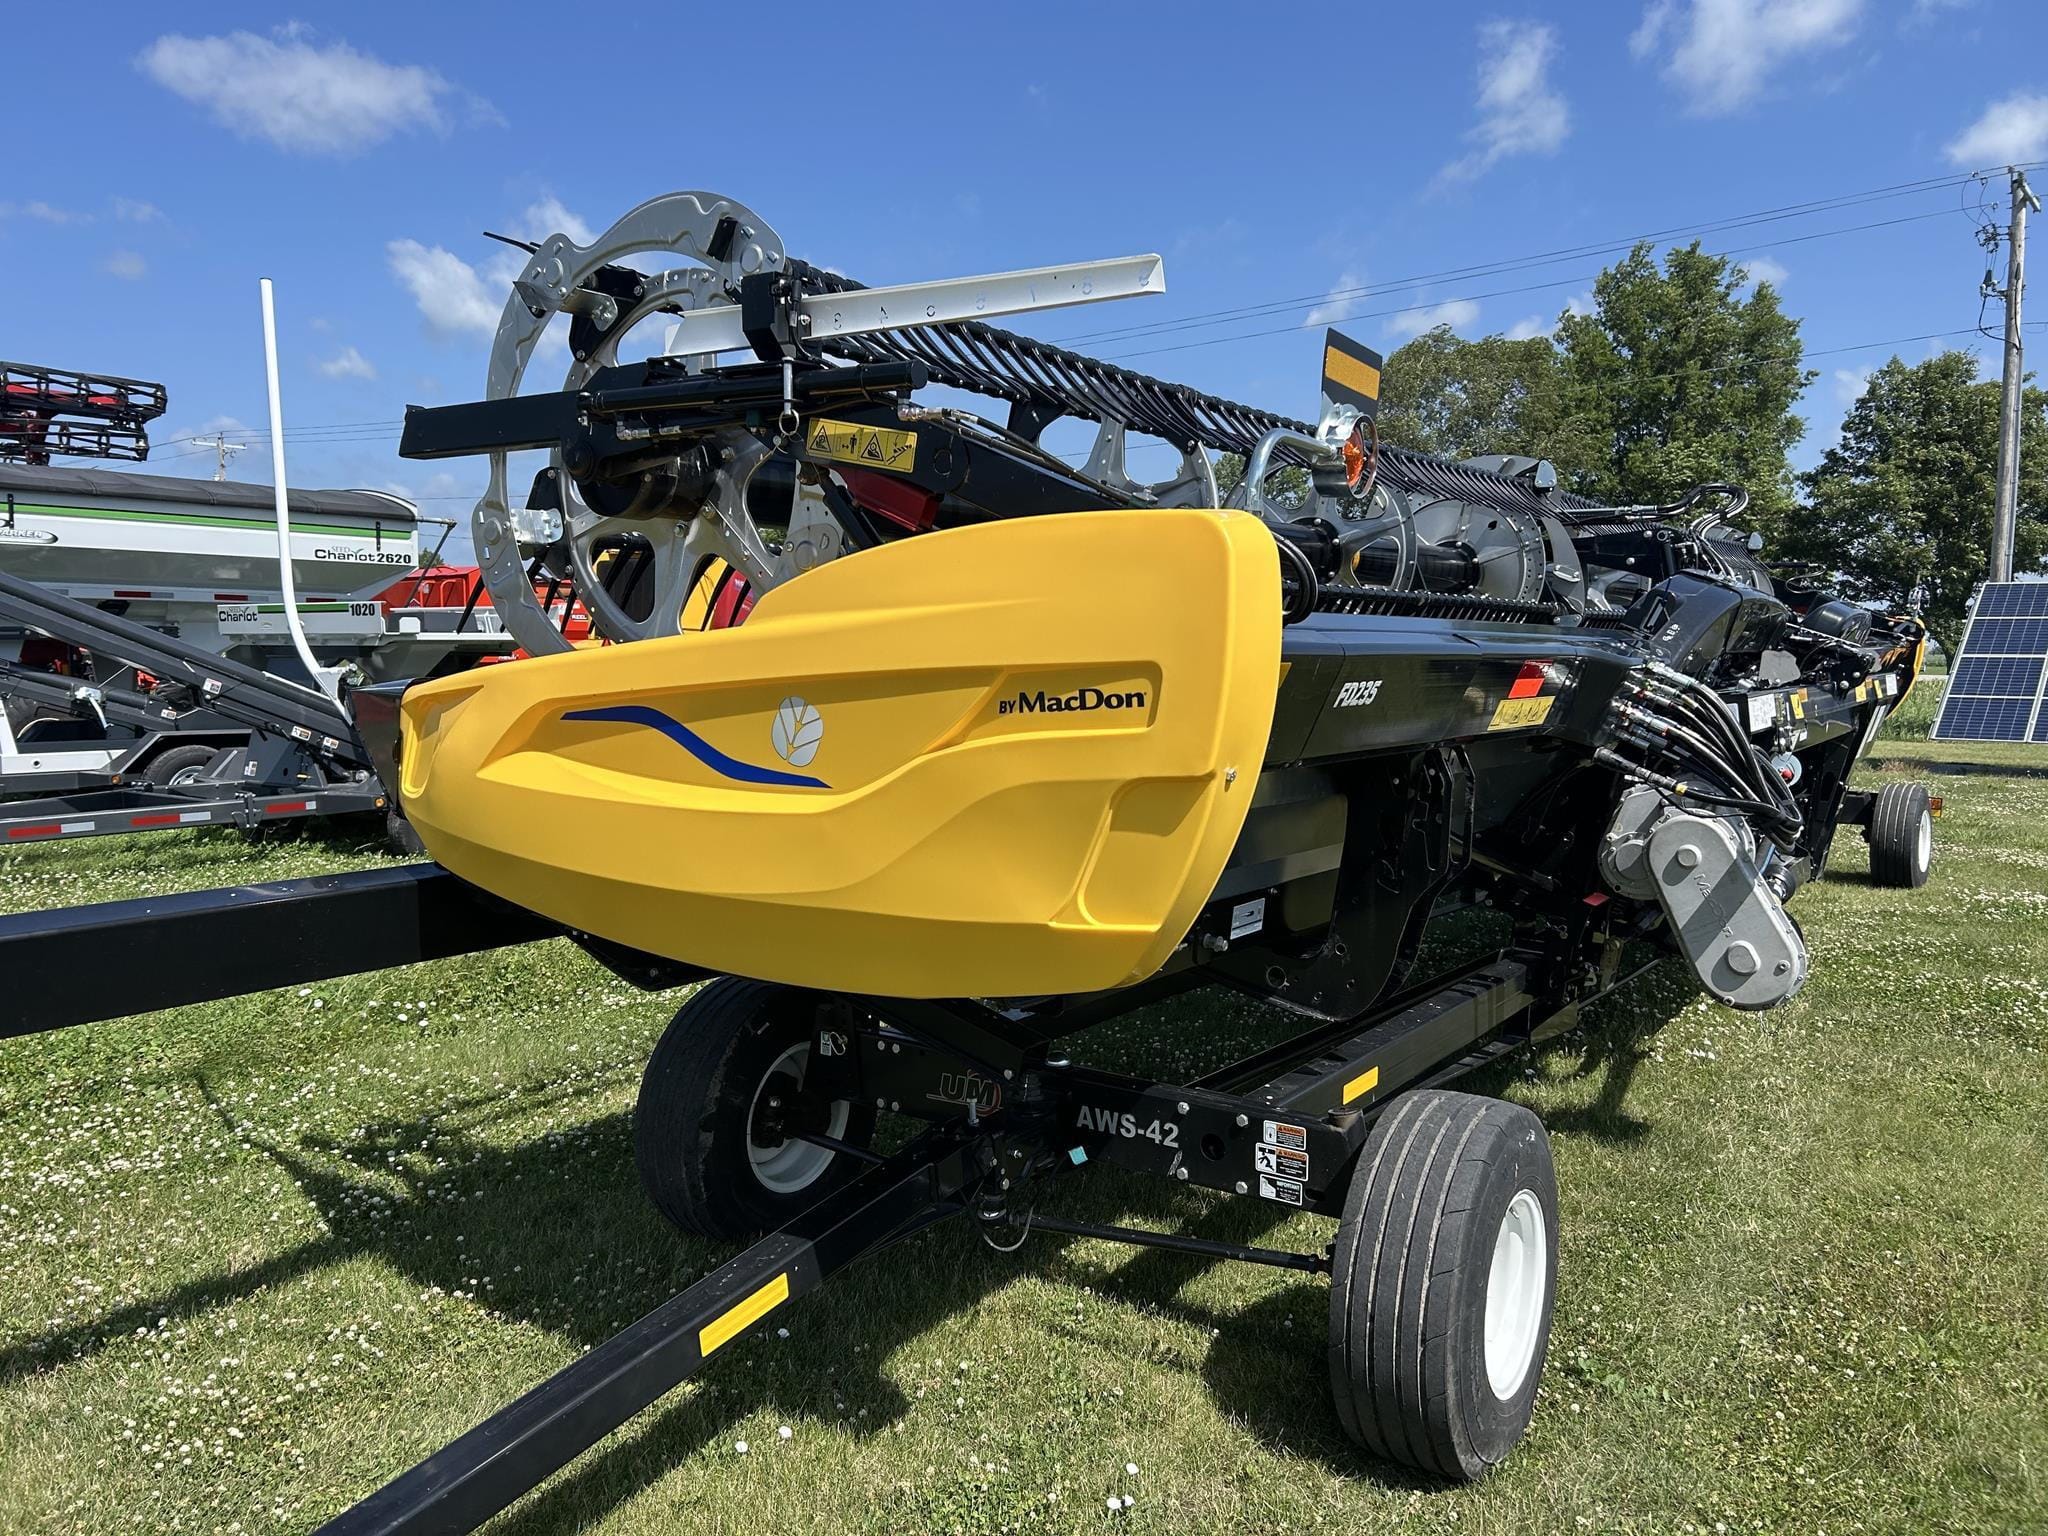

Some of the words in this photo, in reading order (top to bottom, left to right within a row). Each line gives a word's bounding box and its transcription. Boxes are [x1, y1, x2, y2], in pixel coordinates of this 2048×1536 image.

[0, 528, 42, 538] ARKER
[314, 548, 376, 562] Chariot
[377, 553, 412, 564] 2620
[218, 609, 258, 623] Chariot
[350, 604, 375, 617] 1020
[998, 700, 1017, 714] BY
[1019, 688, 1145, 713] MacDon
[1333, 680, 1383, 709] FD235
[1076, 1105, 1179, 1148] AWS-42
